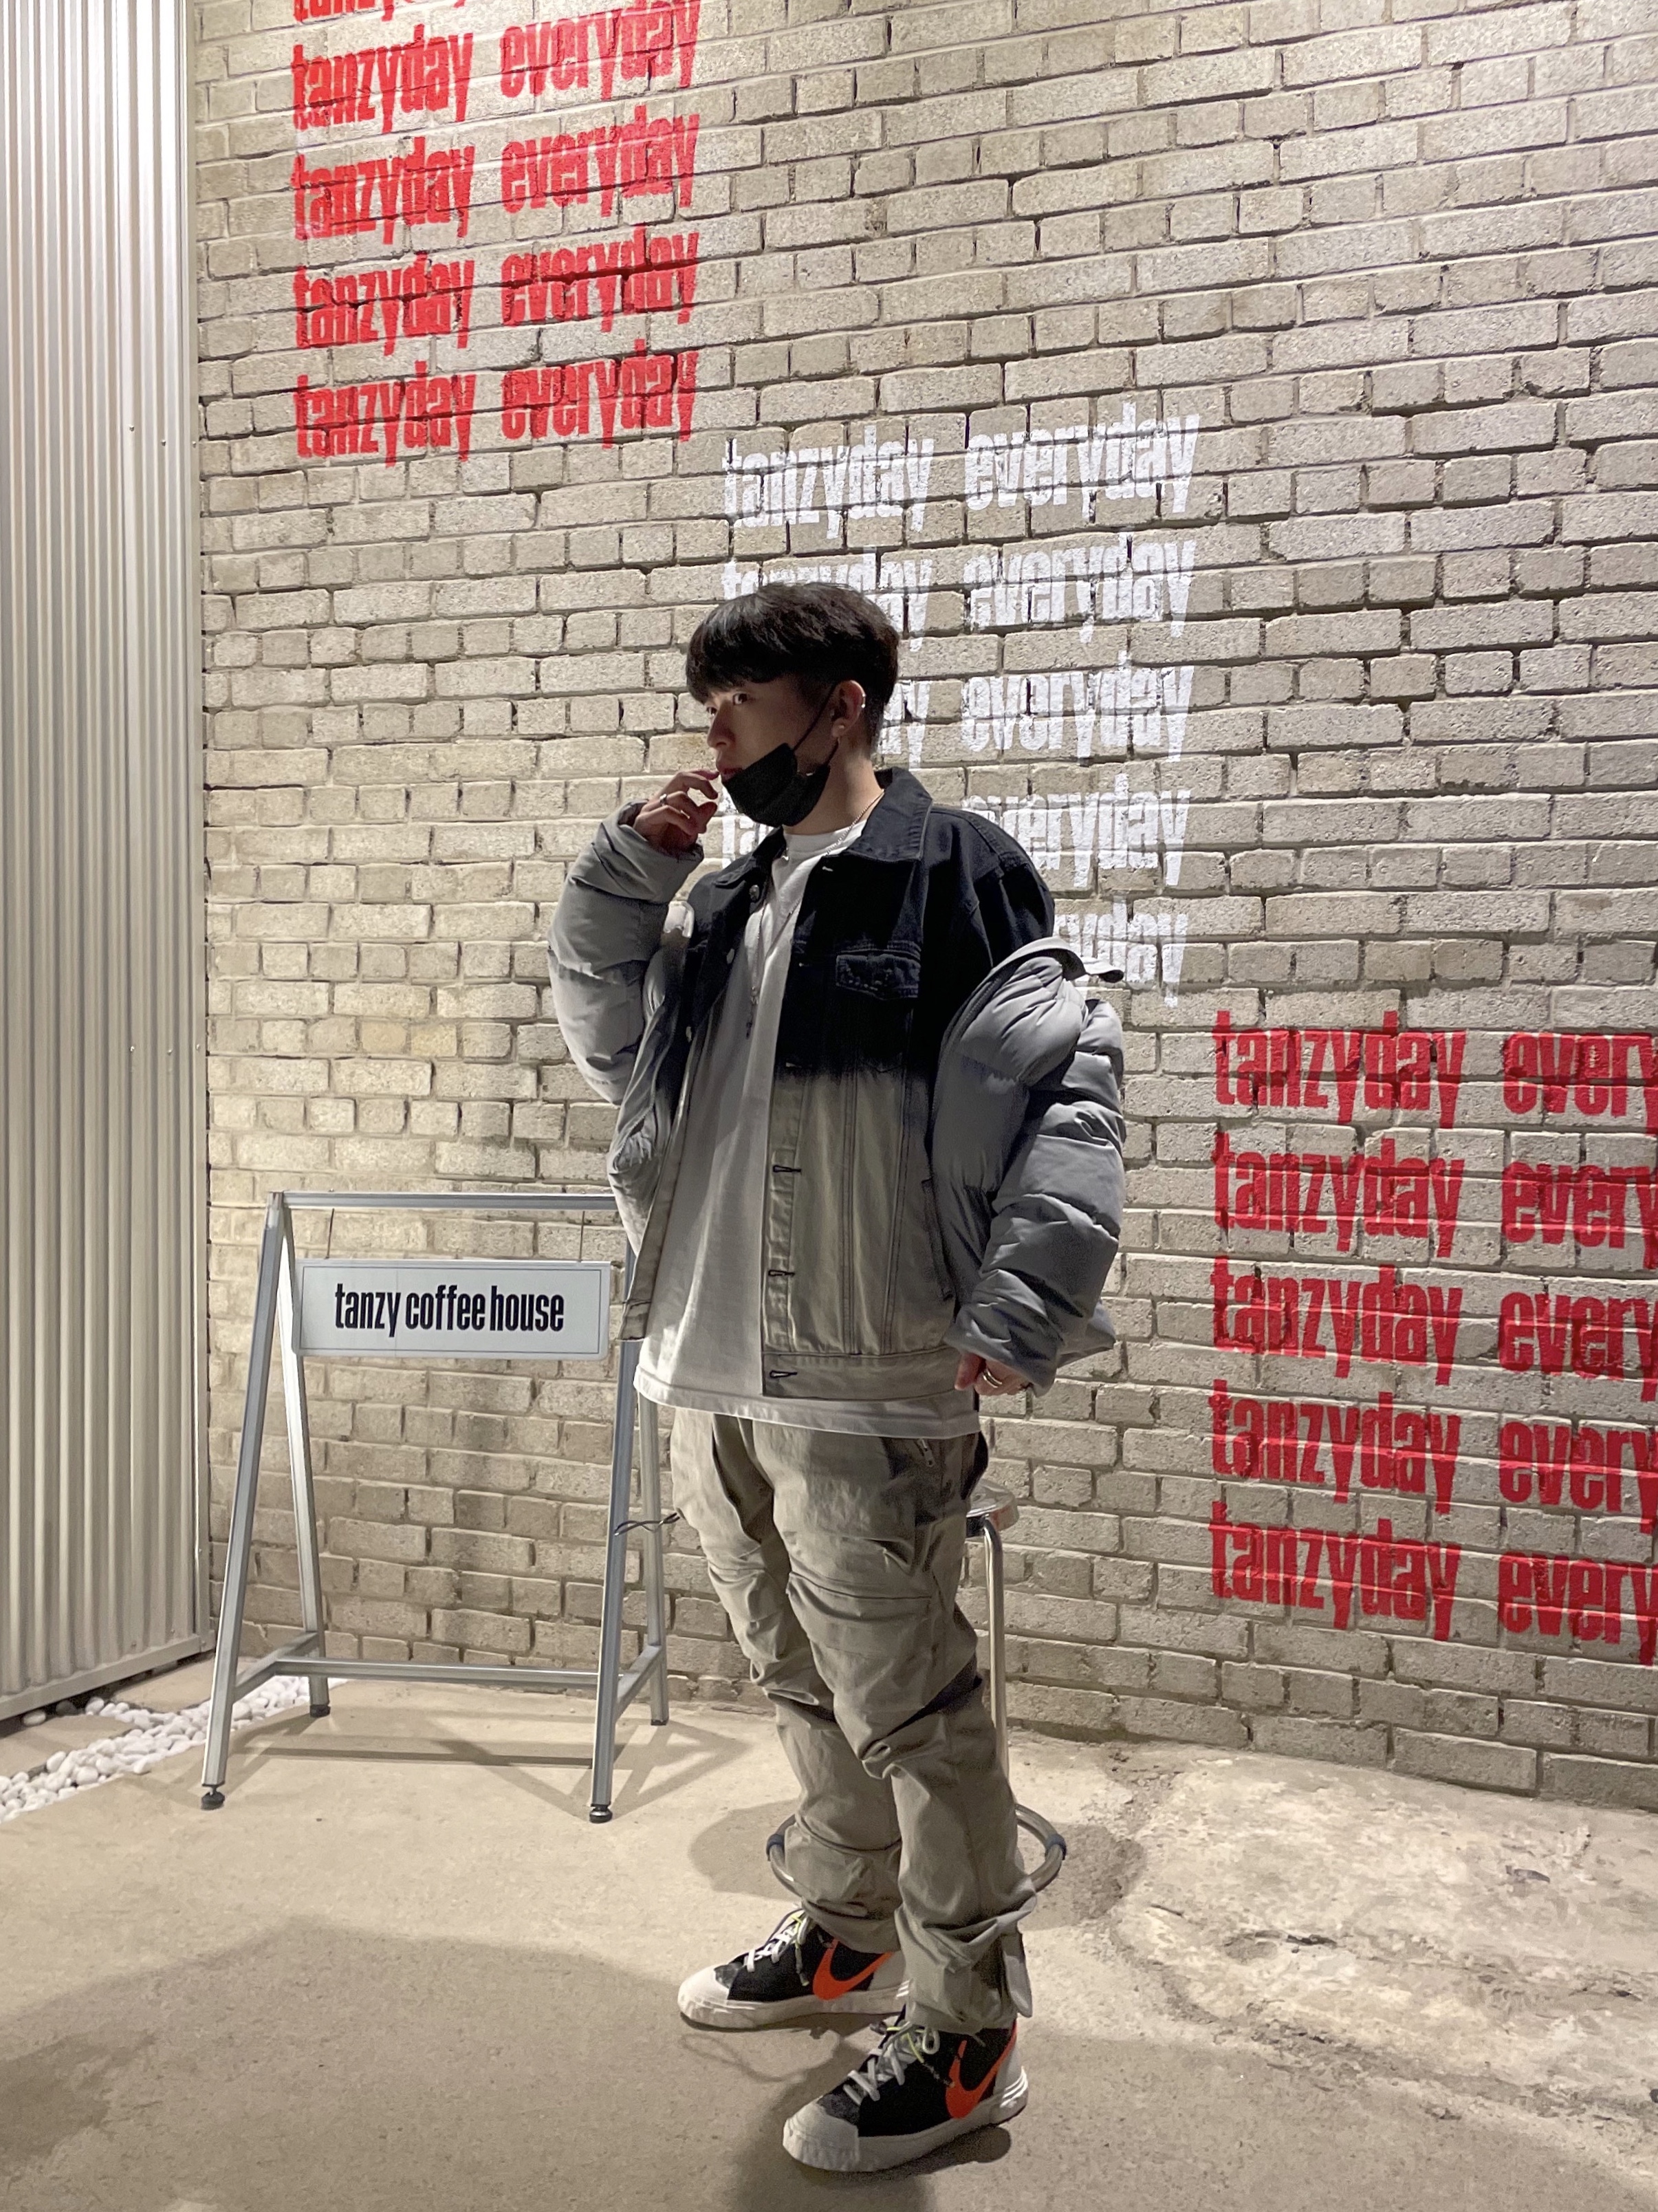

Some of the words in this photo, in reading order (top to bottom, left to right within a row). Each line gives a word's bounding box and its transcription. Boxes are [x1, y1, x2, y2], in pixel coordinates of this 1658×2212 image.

[292, 23, 474, 133] tanzyday
[499, 0, 700, 100] everyday
[291, 136, 475, 244] tanzyday
[501, 105, 700, 217] everyday
[293, 251, 475, 356] tanzyday
[501, 223, 699, 333] everyday
[294, 360, 476, 466] tanzyday
[501, 339, 699, 449] everyday
[722, 425, 934, 539] tanzyday
[966, 402, 1200, 521] everyday
[963, 531, 1197, 643] everyday
[963, 650, 1194, 761] everyday
[1212, 1010, 1466, 1129] tanzyday
[1212, 1132, 1465, 1258] tanzyday
[335, 1283, 401, 1337] tanzy
[405, 1285, 486, 1330] coffee
[490, 1286, 565, 1332] house
[1210, 1255, 1463, 1386] tanzyday
[1208, 1378, 1461, 1515] tanzyday
[1208, 1500, 1461, 1641] tanzyday
